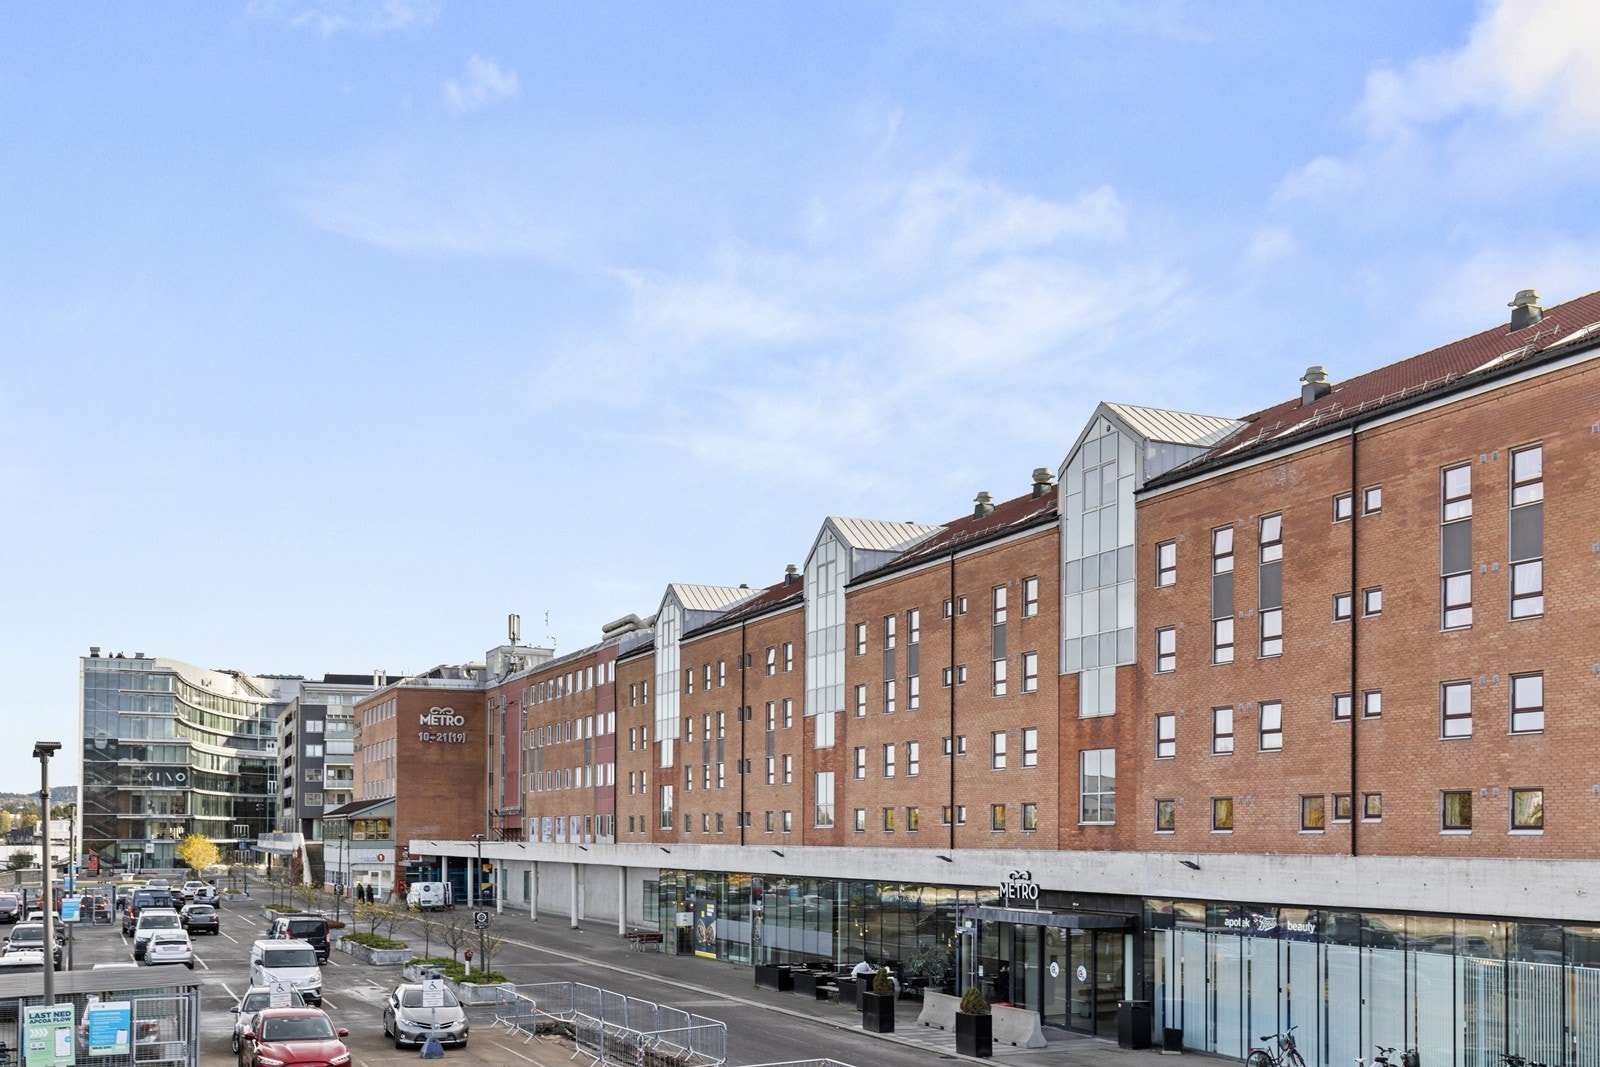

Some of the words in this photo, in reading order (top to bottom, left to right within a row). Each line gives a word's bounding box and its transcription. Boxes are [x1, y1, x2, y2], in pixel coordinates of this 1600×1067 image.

[419, 713, 465, 727] METRO
[1000, 882, 1039, 900] METRO
[1224, 917, 1250, 928] apotek
[1287, 921, 1316, 934] beauty
[29, 1012, 51, 1020] LAST
[53, 1010, 72, 1018] NED
